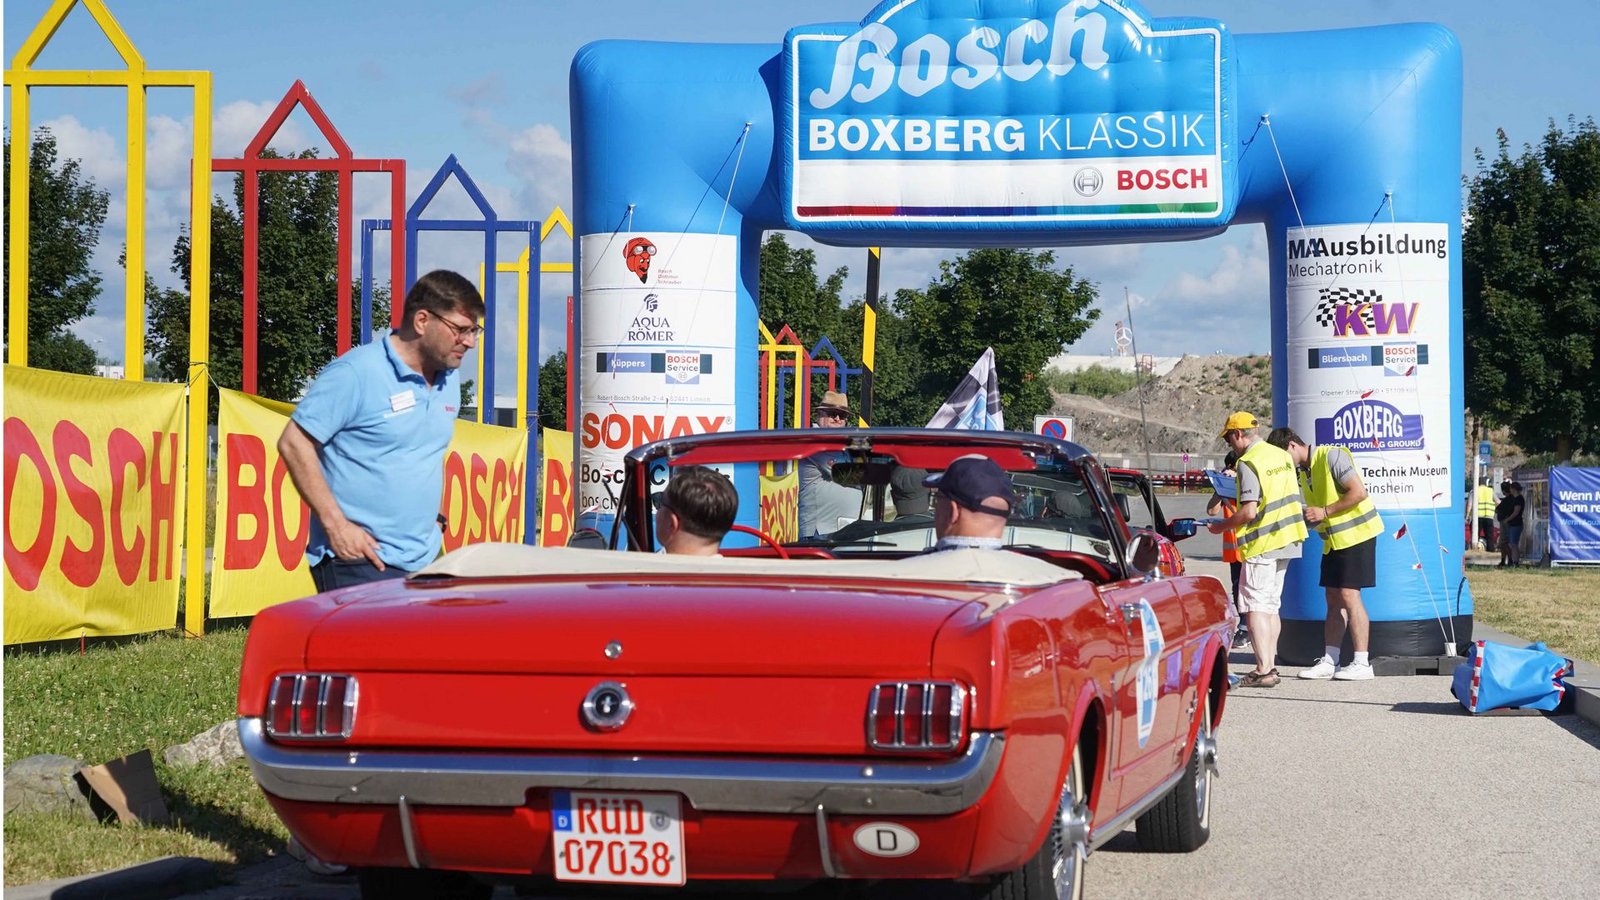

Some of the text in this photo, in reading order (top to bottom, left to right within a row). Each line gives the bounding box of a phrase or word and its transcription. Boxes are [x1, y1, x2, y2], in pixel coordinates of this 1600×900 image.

[809, 0, 1109, 109] Bosch
[809, 113, 1206, 151] BOXBERG KLASSIK
[1117, 168, 1208, 191] BOSCH
[1289, 259, 1383, 277] Mechatronik
[632, 316, 670, 331] AQUA
[1333, 302, 1420, 337] KW
[628, 328, 674, 342] RÖMER
[1321, 354, 1368, 363] Bliersbach
[1385, 347, 1416, 356] BOSCH
[611, 358, 646, 368] Küppers
[667, 355, 699, 364] BOSCH
[1385, 356, 1416, 364] Service
[667, 364, 699, 372] Service
[1333, 405, 1404, 440] BOXBERG
[1348, 442, 1386, 450] PROVIG
[1387, 440, 1422, 449] GROUND
[581, 463, 625, 485] Bosc
[1361, 466, 1407, 478] Technik
[1409, 465, 1448, 477] Museum
[442, 450, 524, 554] OSCH
[1559, 490, 1592, 501] Wenn
[3, 416, 179, 592] OSCH
[1559, 502, 1587, 513] dann
[876, 829, 898, 851] D
[564, 839, 671, 877] 07038
